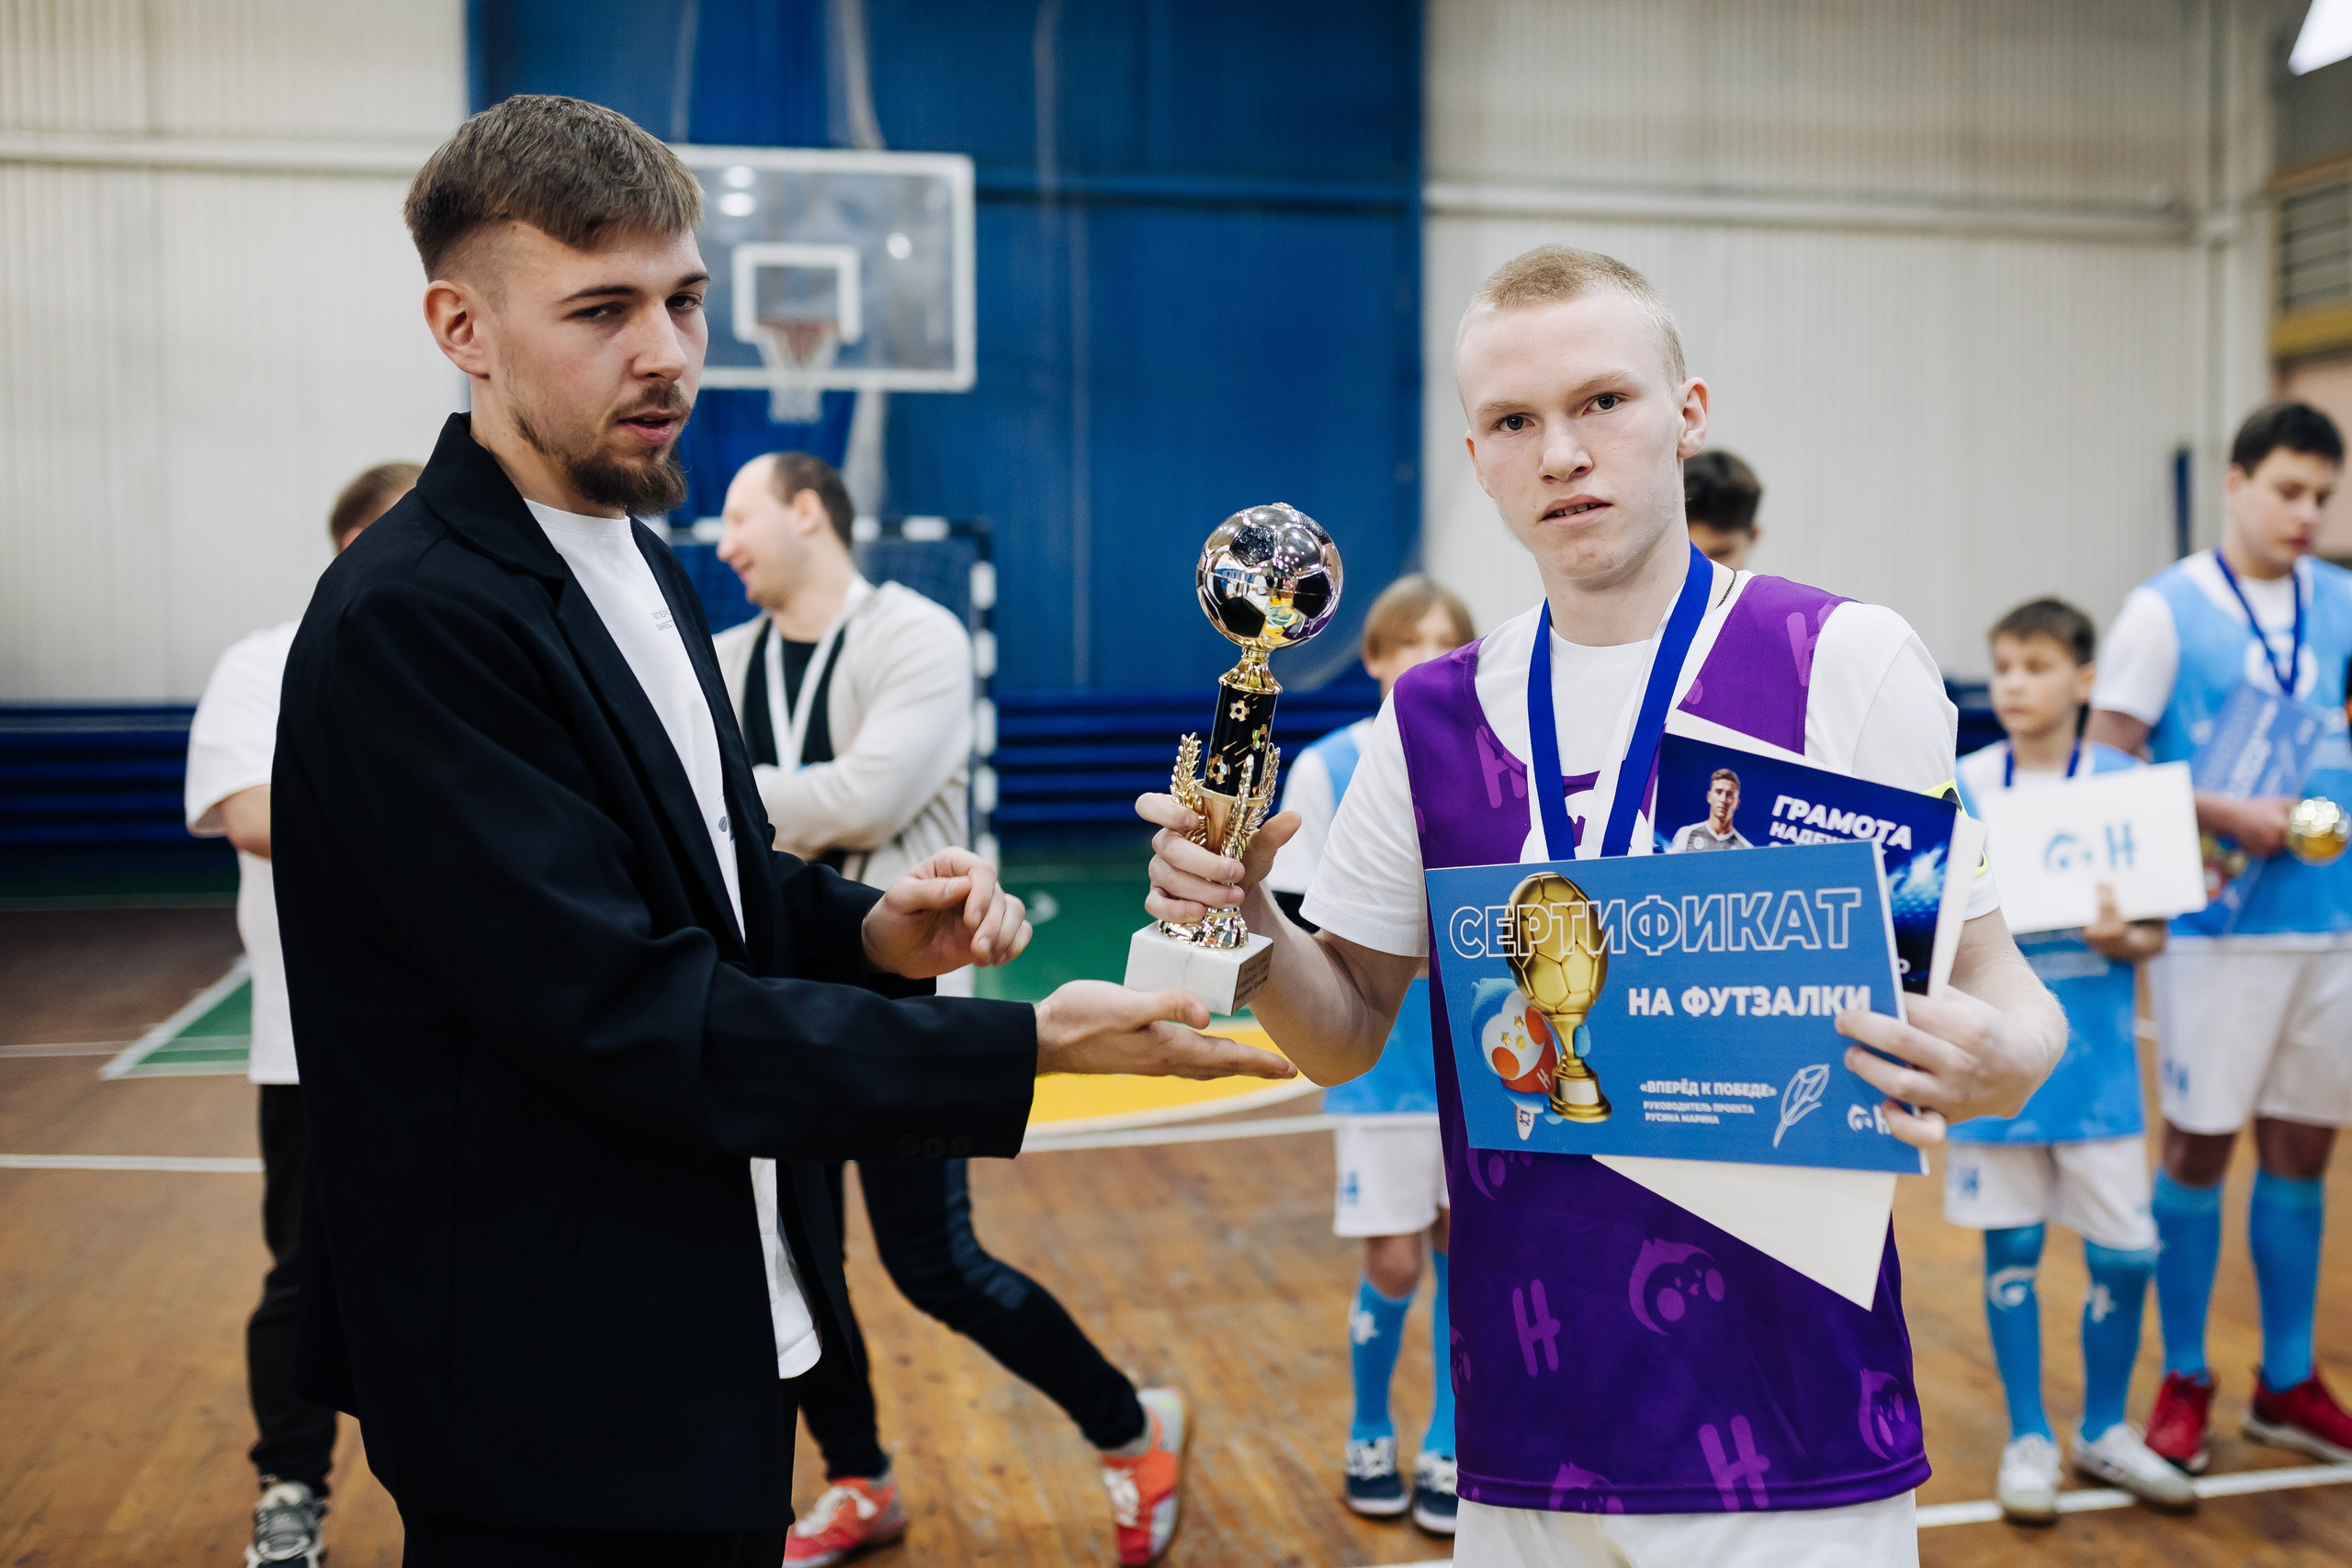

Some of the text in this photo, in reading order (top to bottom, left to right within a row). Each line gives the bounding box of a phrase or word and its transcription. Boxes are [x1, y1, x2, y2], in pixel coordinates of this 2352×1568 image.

[651, 606, 673, 620] ВПЕРЁ
[655, 619, 675, 632] ВМЕСТ
[1769, 820, 1848, 846] НАДЕ
[1771, 794, 1913, 851] ГРАМОТА
[1450, 887, 1862, 959] СЕРТИФИКАТ
[1628, 984, 1871, 1017] НА ФУТЗАЛКИ
[1639, 1077, 1778, 1099] «ВПЕРЁД К ПОБЕДЕ»
[1643, 1100, 1756, 1114] РУКОВОДИТЕЛЬ ПРОЕКТА
